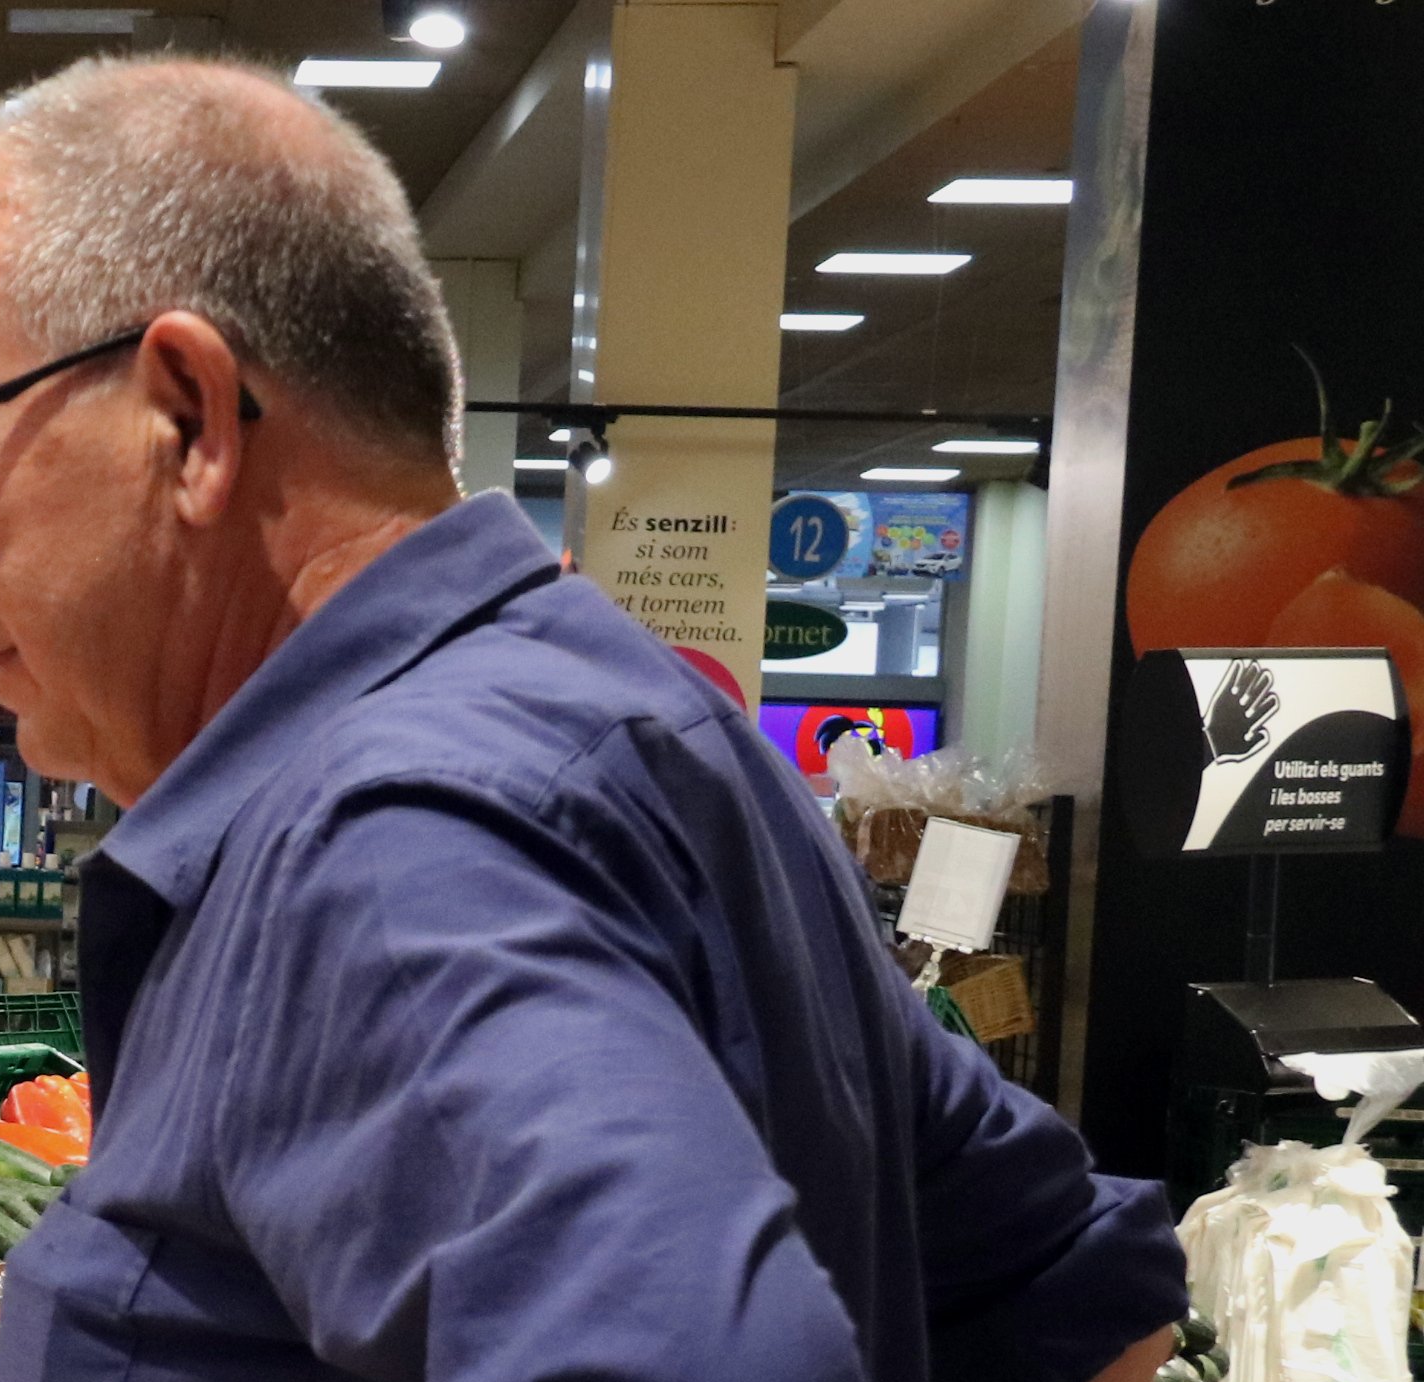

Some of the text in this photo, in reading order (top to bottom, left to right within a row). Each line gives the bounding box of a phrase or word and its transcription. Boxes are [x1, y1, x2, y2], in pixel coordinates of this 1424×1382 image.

[612, 506, 737, 534] És senzill:
[635, 539, 708, 560] si som
[790, 515, 824, 563] 12
[616, 568, 725, 590] més cars,
[640, 596, 725, 615] tornem
[1274, 760, 1384, 782] Utilitzi els guants
[1277, 788, 1297, 805] les
[1297, 788, 1342, 805] bosses
[1263, 813, 1346, 836] per servir-se
